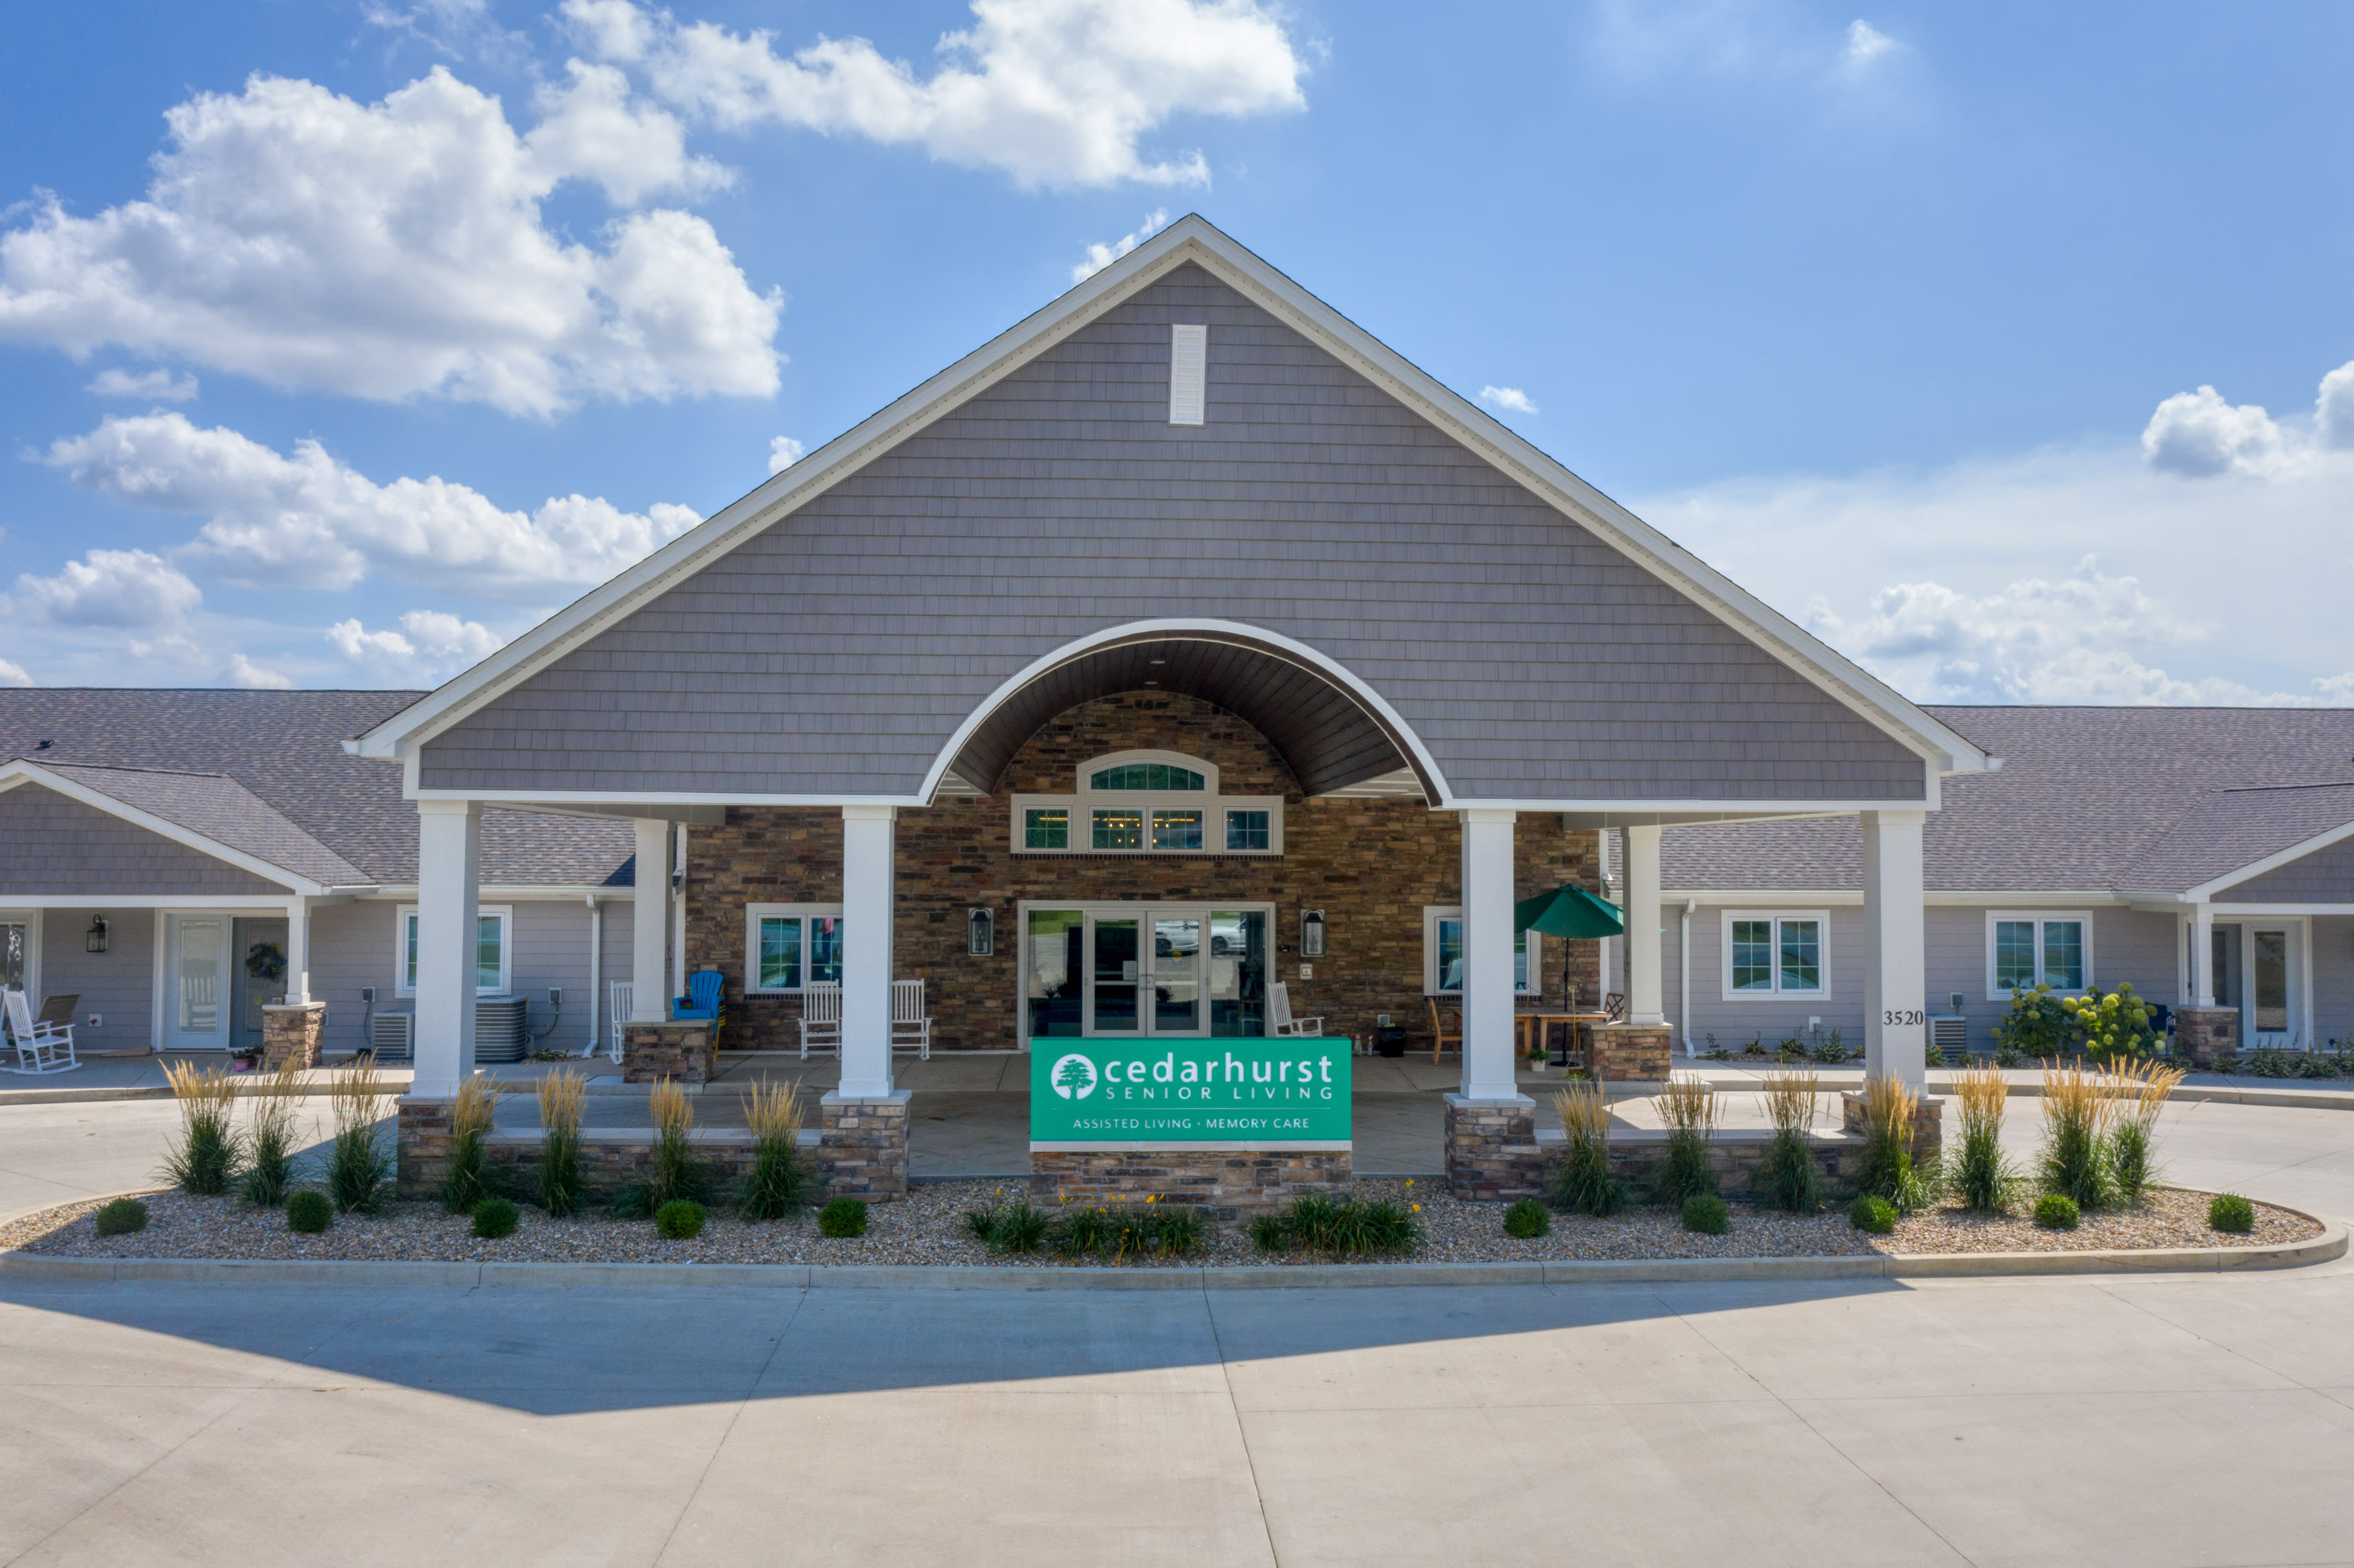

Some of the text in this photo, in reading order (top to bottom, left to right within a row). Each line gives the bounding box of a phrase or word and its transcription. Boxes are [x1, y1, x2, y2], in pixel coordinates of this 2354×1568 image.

[1883, 1010, 1924, 1025] 3520
[1105, 1052, 1332, 1083] cedarhurst
[1106, 1086, 1332, 1100] SENIOR LIVING
[1073, 1118, 1309, 1129] ASSISTED LIVING MEMORY CARE
